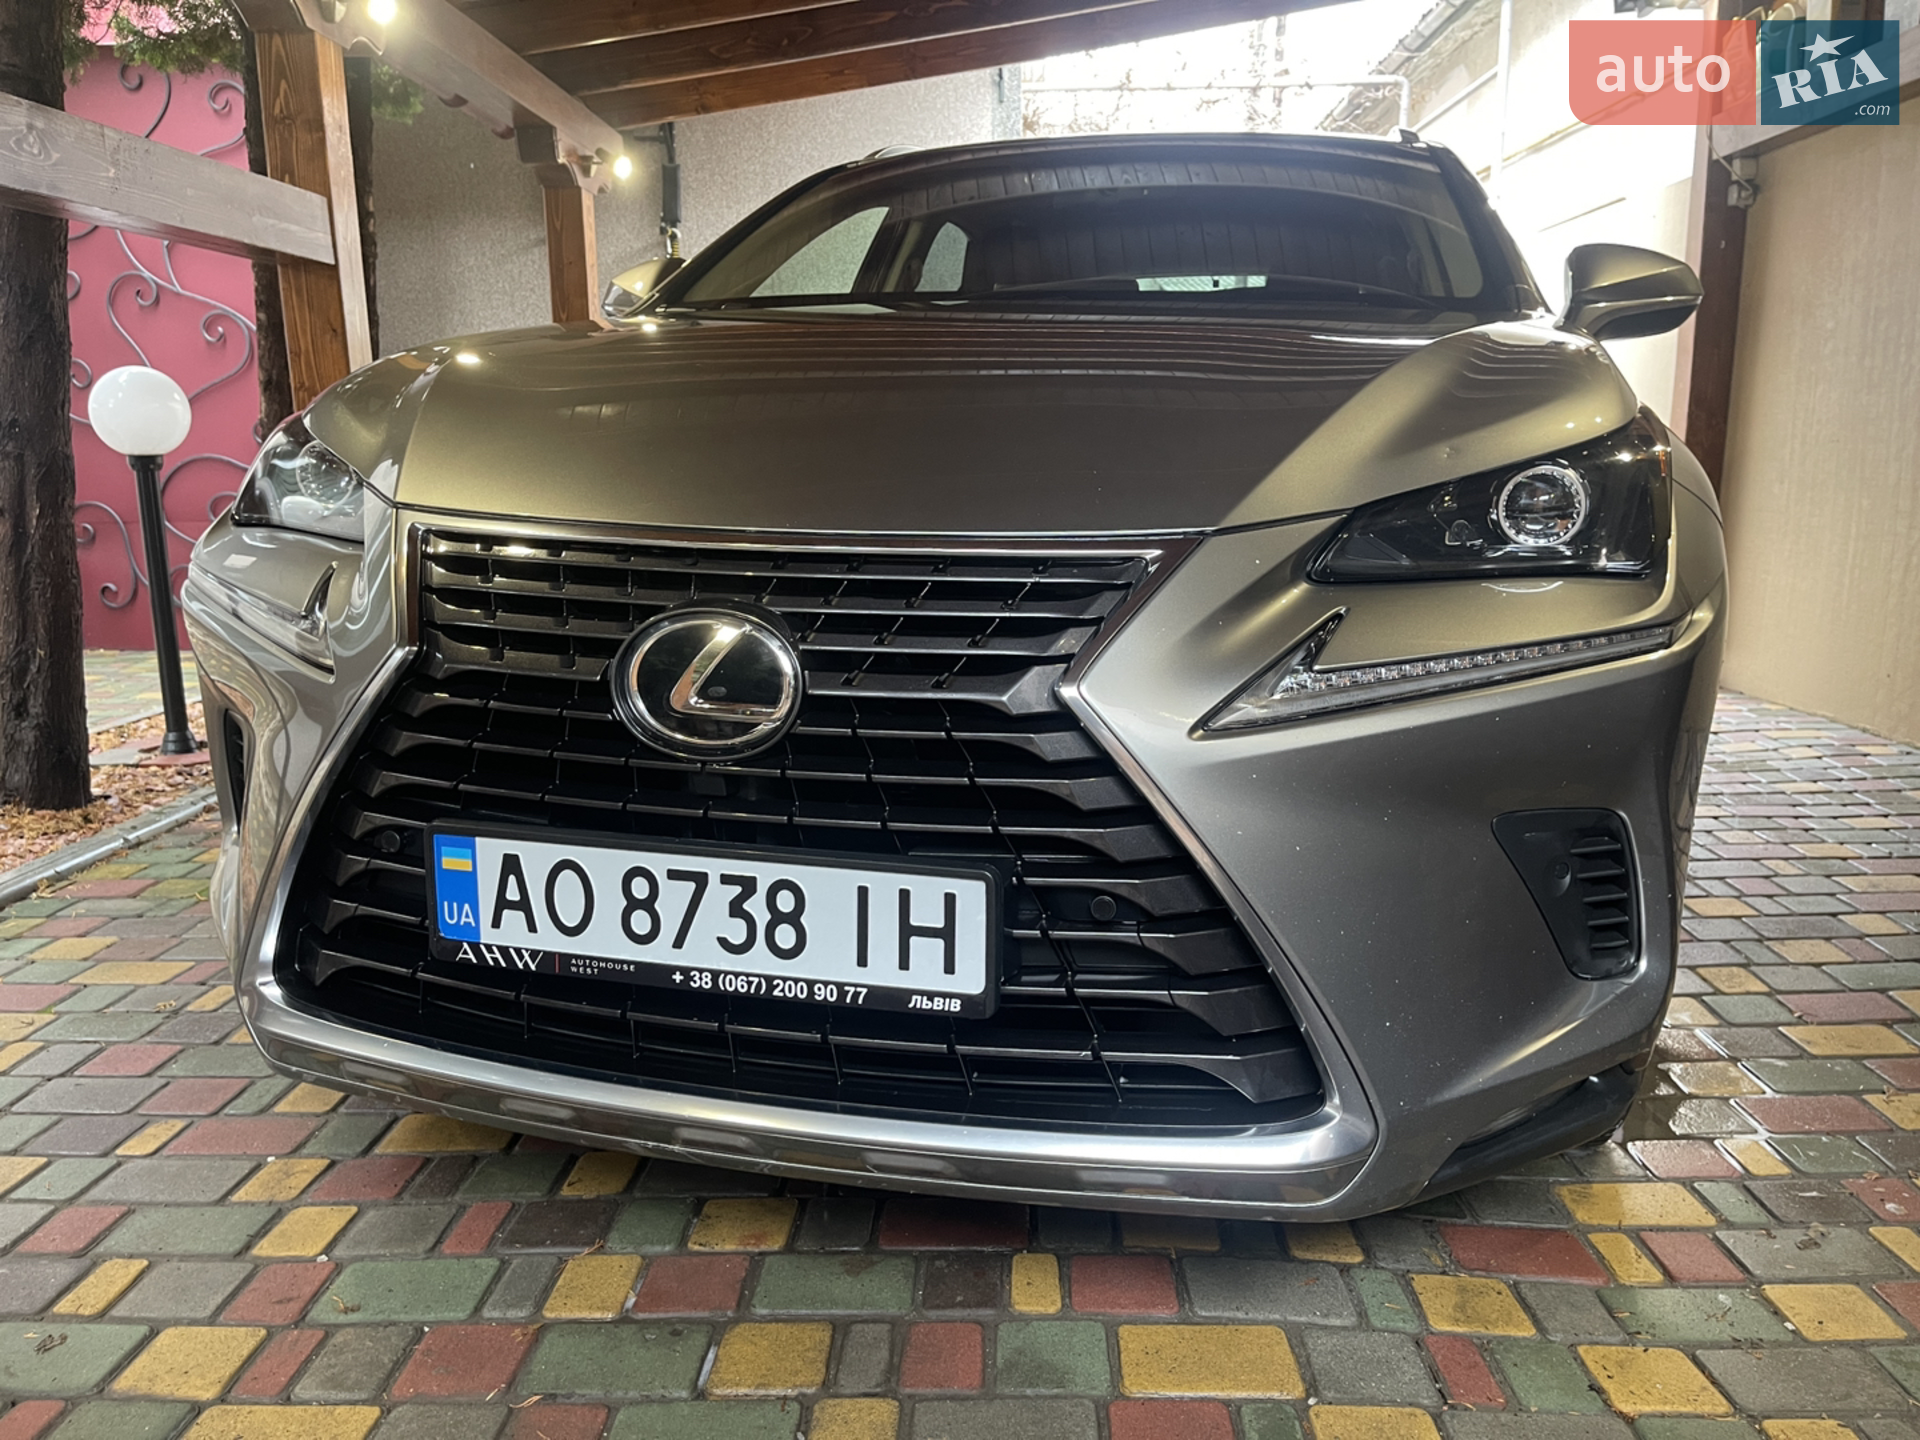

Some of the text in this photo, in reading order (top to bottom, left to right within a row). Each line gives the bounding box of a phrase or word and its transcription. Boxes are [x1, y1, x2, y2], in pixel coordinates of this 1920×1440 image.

[443, 901, 476, 928] UA
[620, 865, 808, 961] 8738
[456, 942, 544, 971] AHW
[571, 958, 636, 972] AUTOHOUSE
[571, 966, 599, 975] WEST
[689, 971, 713, 989] 38
[717, 973, 767, 995] (067)
[772, 979, 807, 999] 200
[813, 984, 838, 1002] 90
[844, 986, 868, 1005] 77
